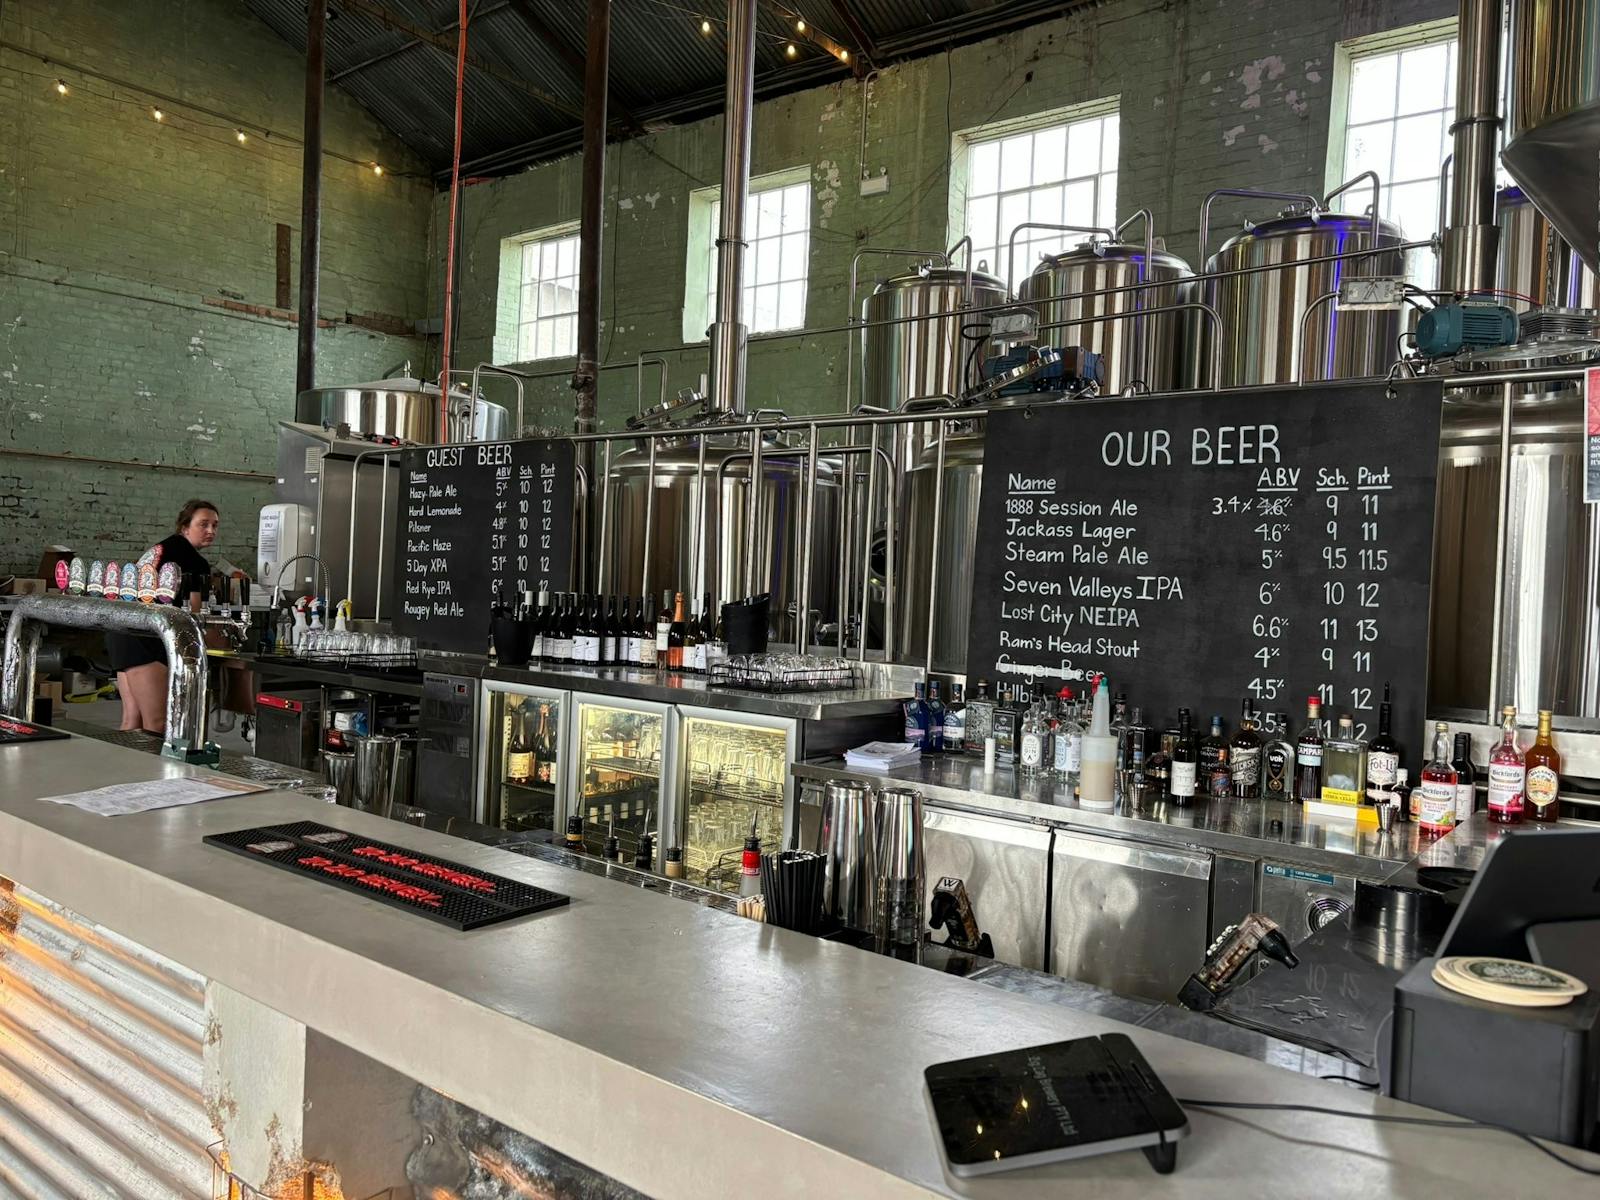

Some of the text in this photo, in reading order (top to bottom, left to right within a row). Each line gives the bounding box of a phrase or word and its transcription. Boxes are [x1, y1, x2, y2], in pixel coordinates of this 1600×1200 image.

[426, 444, 512, 467] GUEST BEER
[1102, 425, 1280, 466] OUR BEER
[1009, 467, 1390, 492] Name A.B.V Sch. Pint
[1005, 499, 1034, 516] 1888
[1039, 500, 1101, 515] Session
[1110, 500, 1137, 515] Ale
[1327, 496, 1337, 515] 9
[1362, 495, 1378, 514] 11
[1007, 519, 1377, 548] Jackass Lager 4.6% 9 11
[1006, 542, 1387, 570] Steam Pale Ale 5% 9.5 11.5
[1003, 571, 1379, 608] Seven Valleys IPA 6% 10 12
[1002, 602, 1378, 641] Lost City NEIPA 6.6% 11 13
[1049, 634, 1091, 654] Head
[1096, 638, 1139, 657] Stout
[1255, 647, 1280, 667] 4%
[1322, 648, 1332, 670] 9
[1353, 651, 1370, 672] 11
[1248, 678, 1284, 699] 4.5%
[1316, 684, 1333, 707] 11
[1351, 688, 1372, 709] 12
